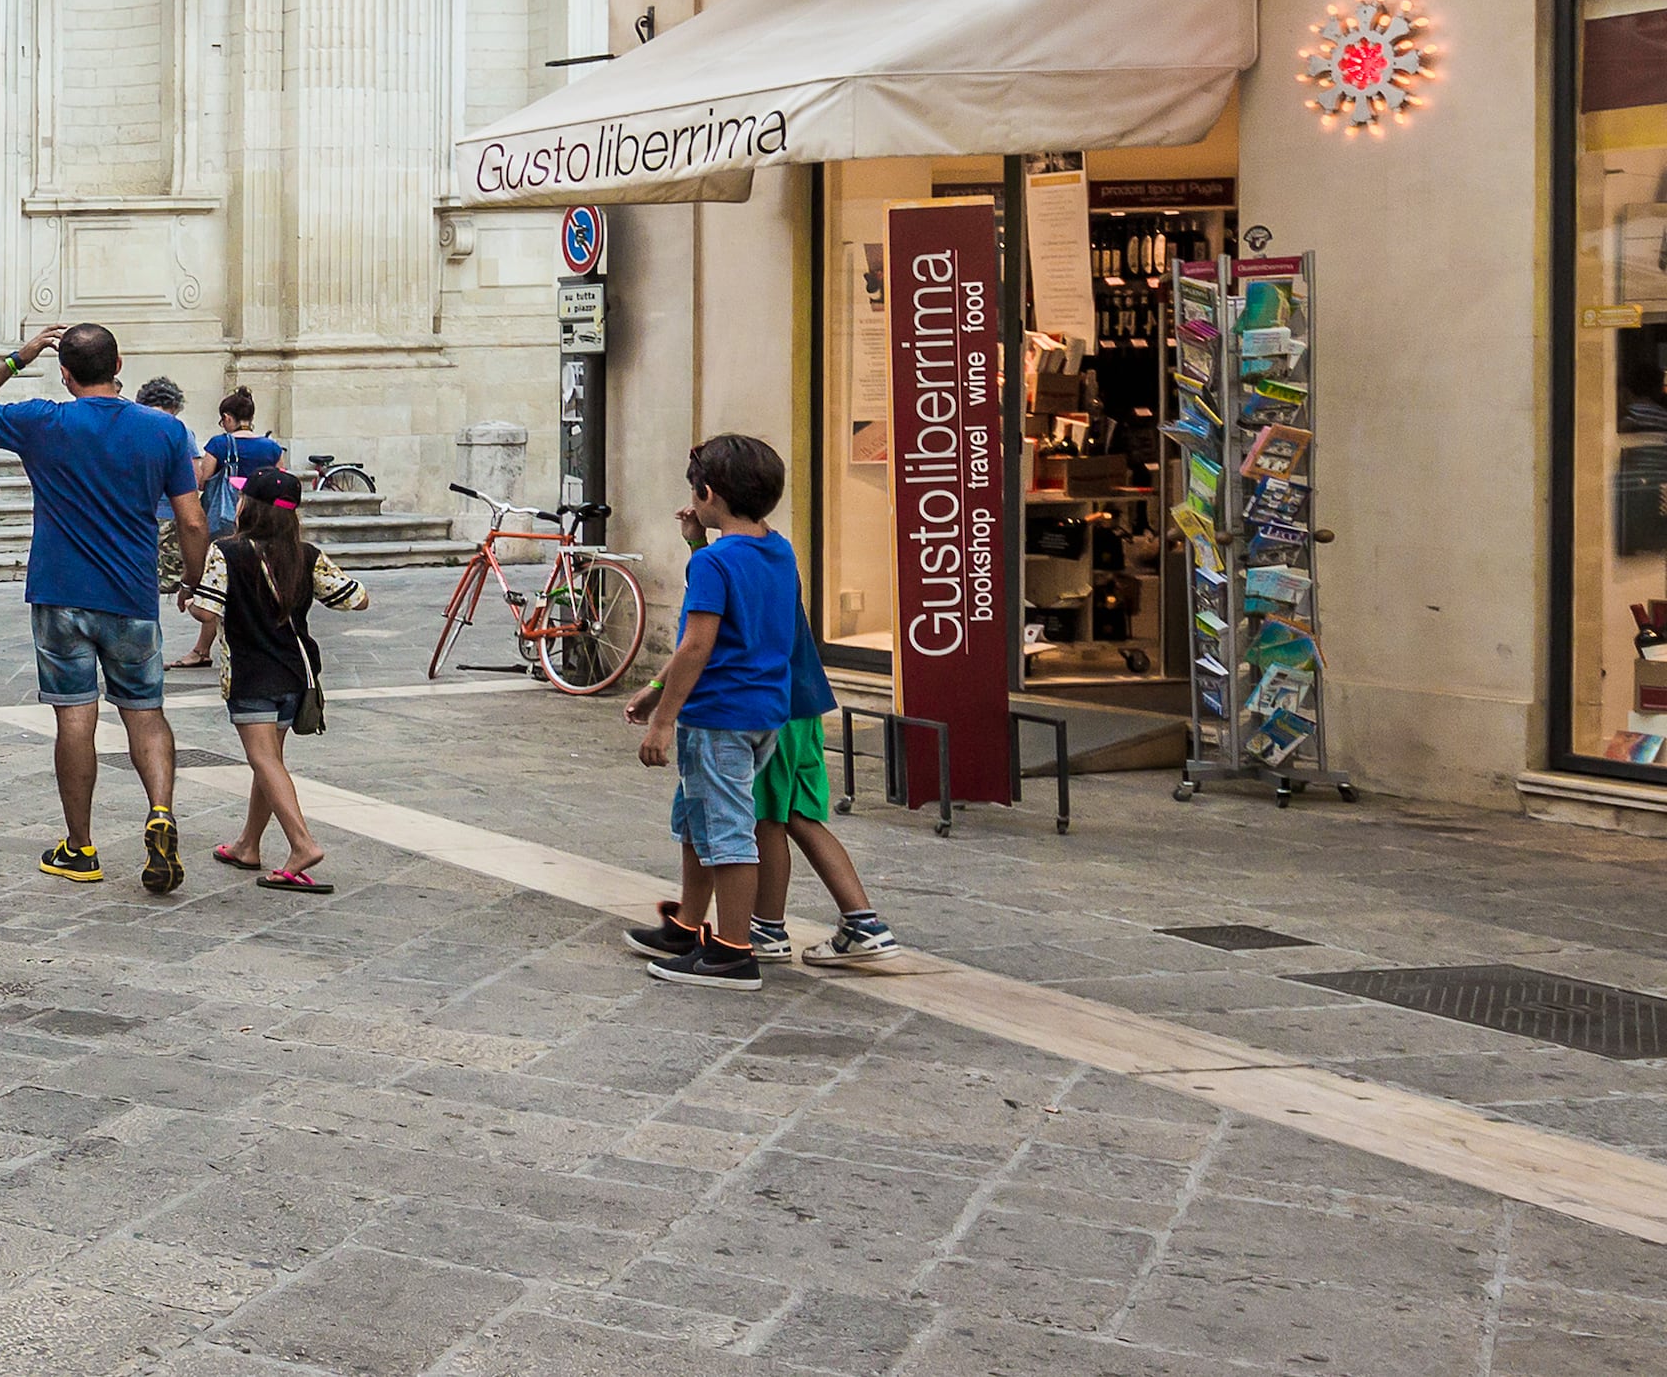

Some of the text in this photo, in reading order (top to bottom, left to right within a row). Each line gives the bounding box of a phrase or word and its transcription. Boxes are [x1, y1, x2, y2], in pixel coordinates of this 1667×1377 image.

[576, 292, 595, 301] tutta
[960, 280, 996, 622] bookshop travel wine food
